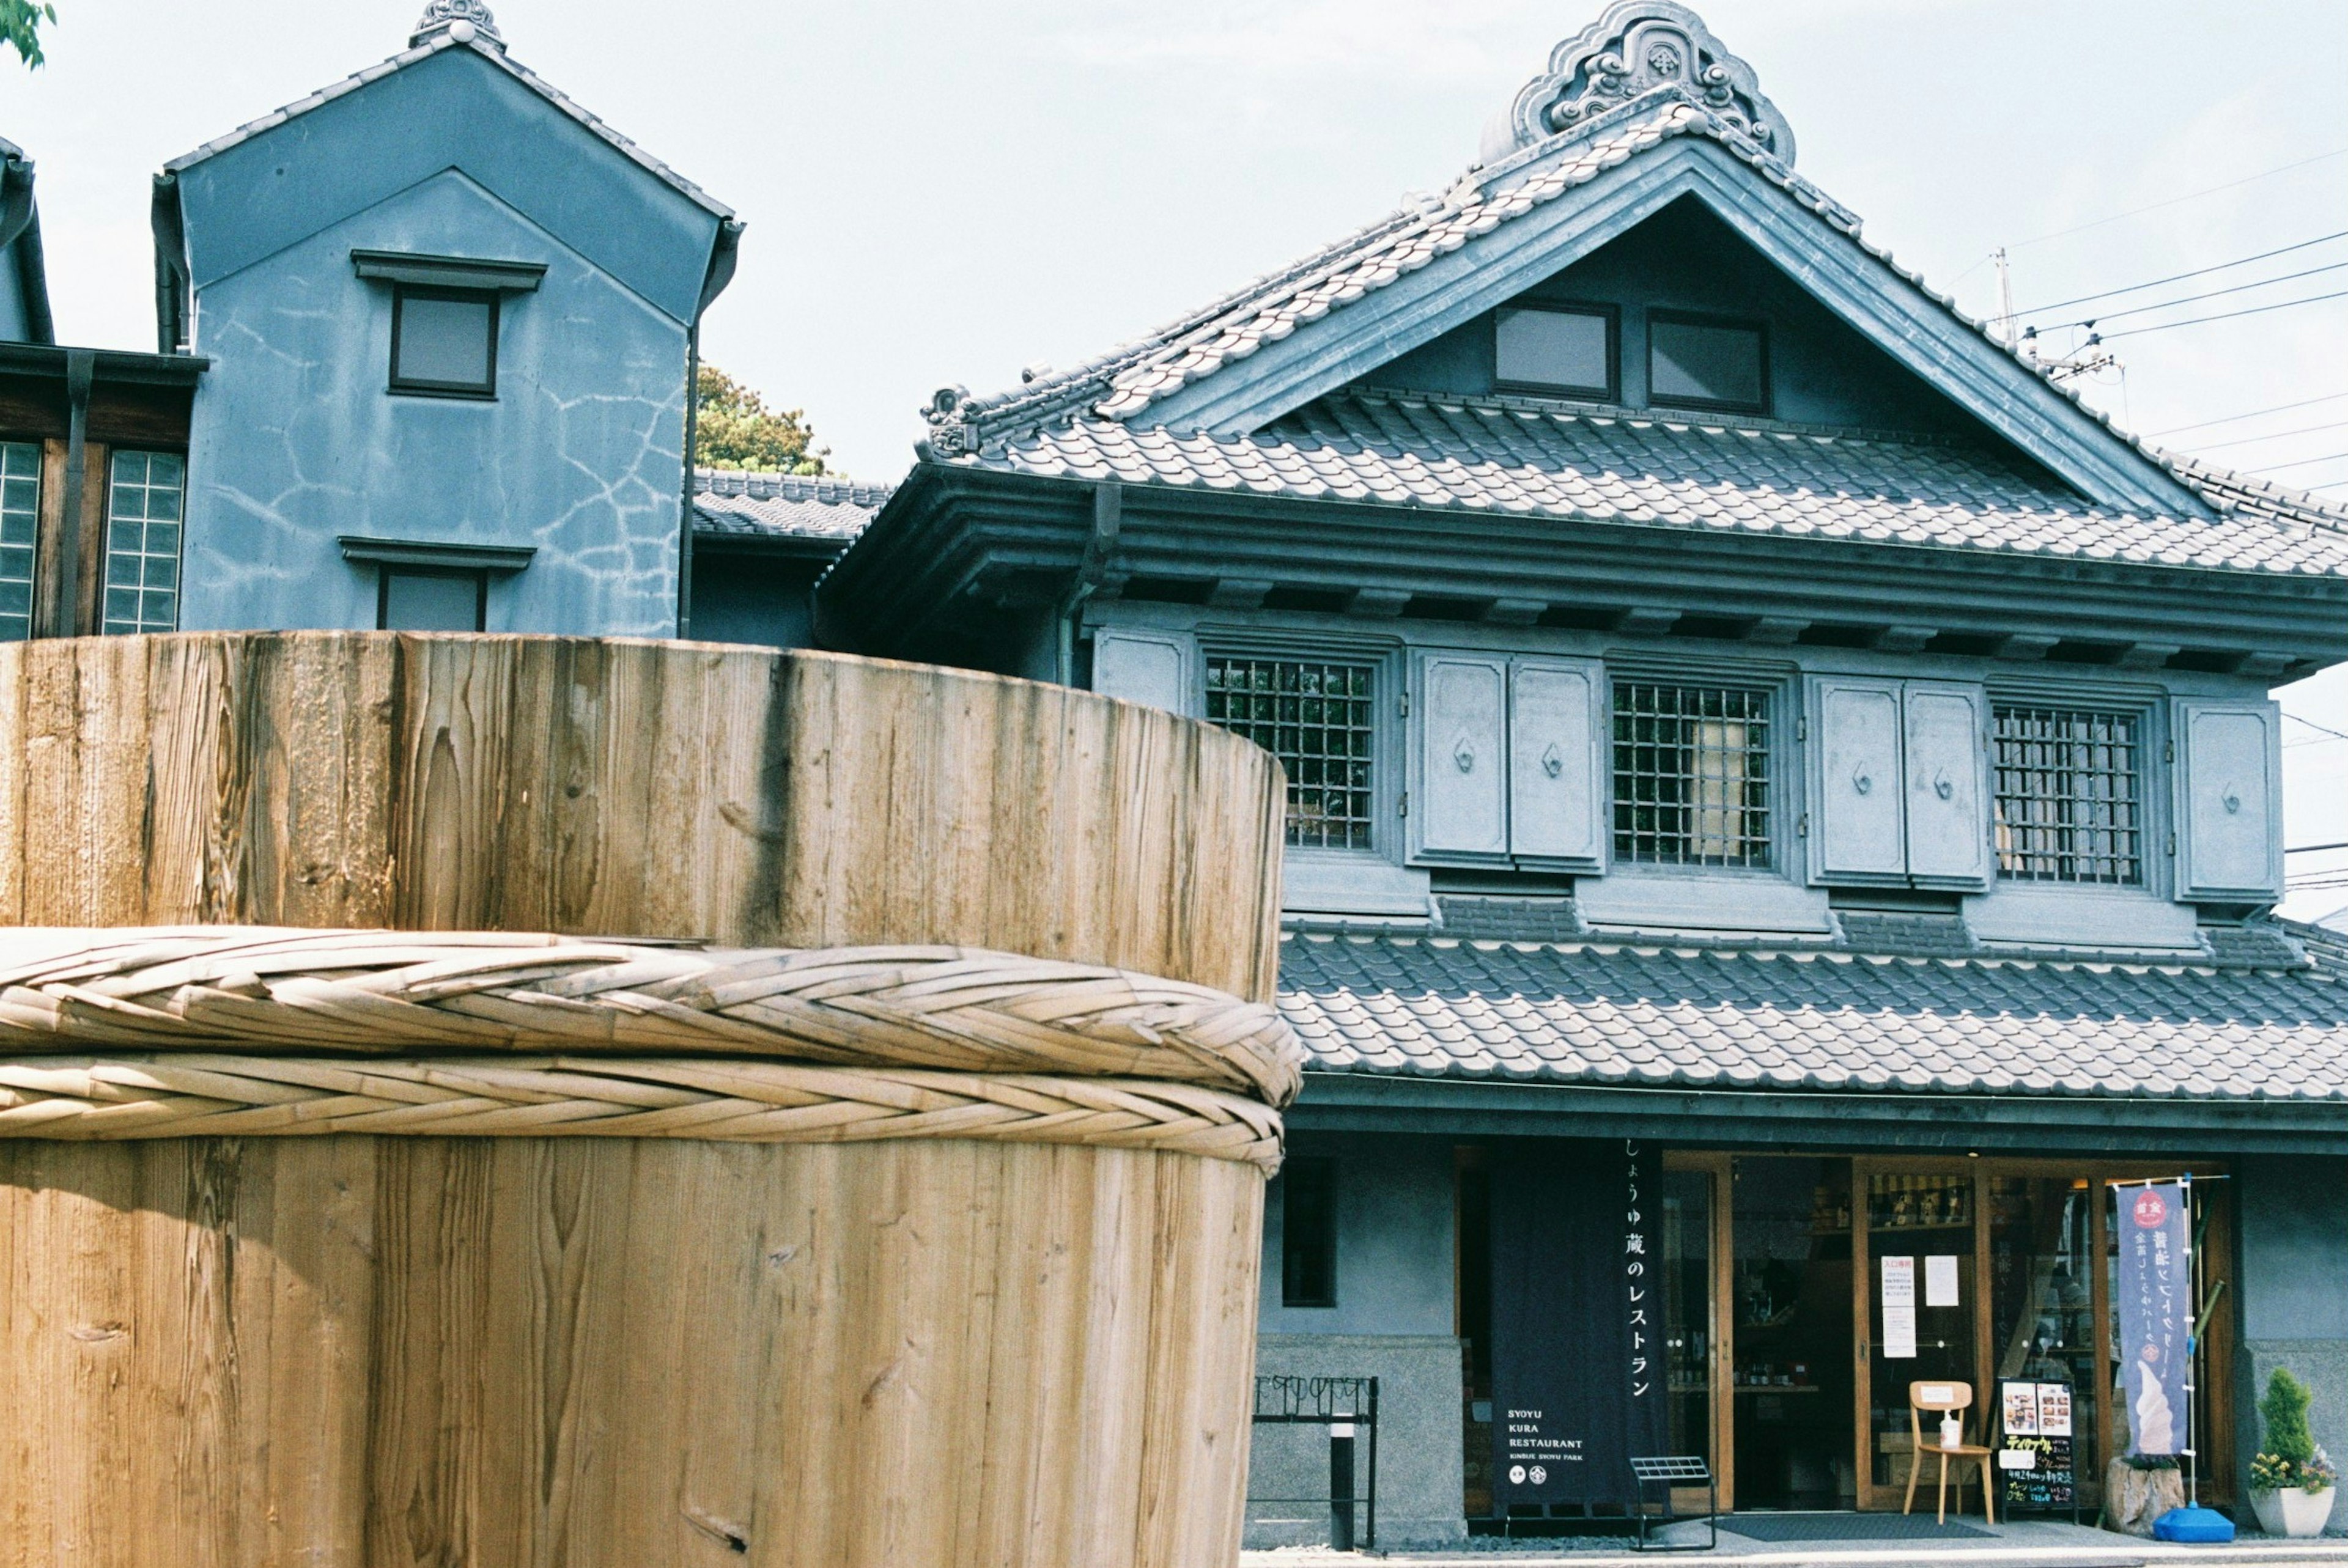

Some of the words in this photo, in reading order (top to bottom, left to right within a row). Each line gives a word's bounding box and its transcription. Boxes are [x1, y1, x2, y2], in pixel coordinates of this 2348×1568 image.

[1625, 1139, 1649, 1396] しょうゆ蔵のレストラン
[1508, 1410, 1541, 1418] SYOYU
[1509, 1438, 1582, 1448] RESTAURANT
